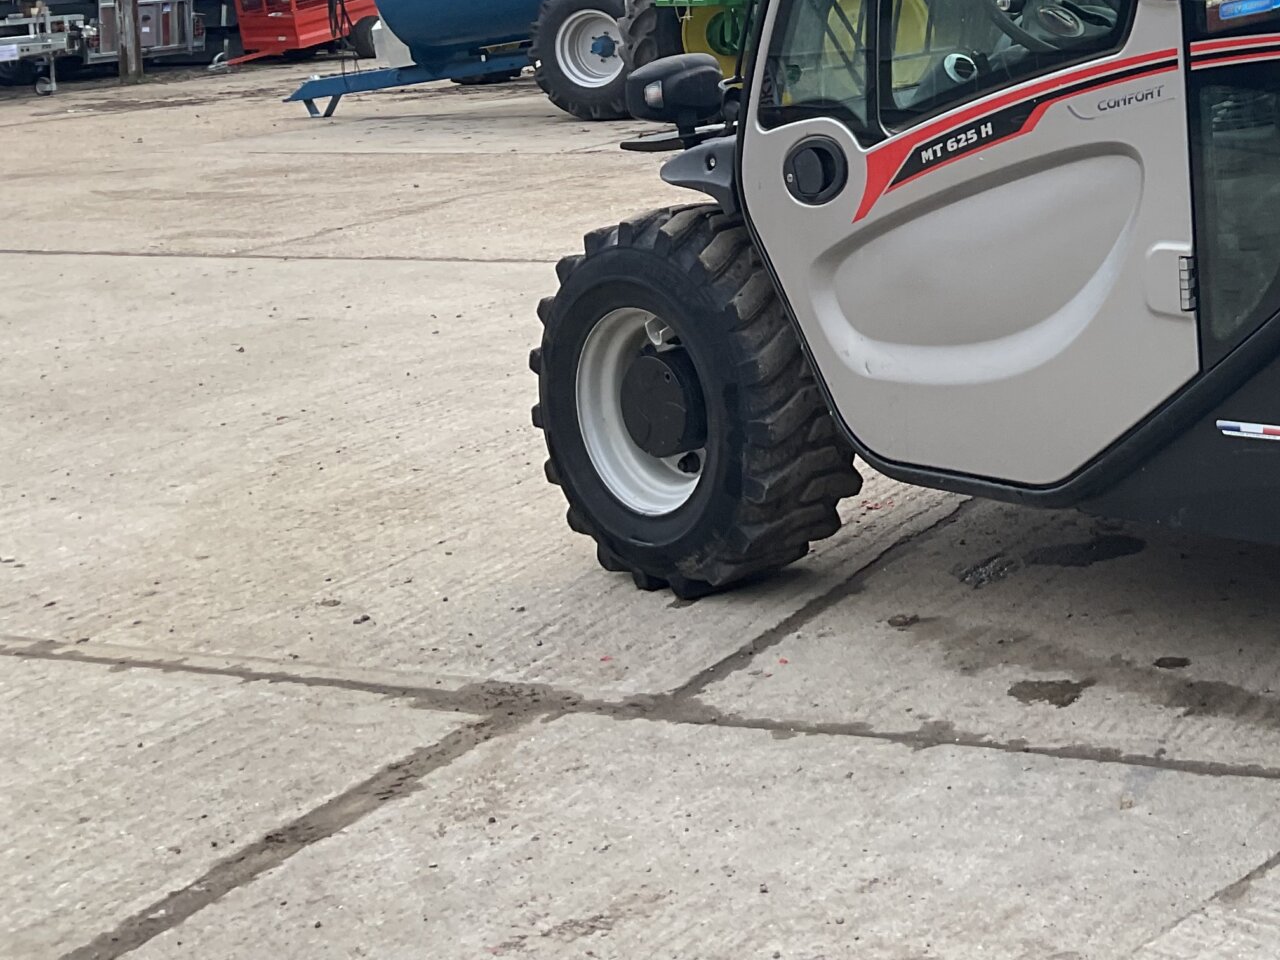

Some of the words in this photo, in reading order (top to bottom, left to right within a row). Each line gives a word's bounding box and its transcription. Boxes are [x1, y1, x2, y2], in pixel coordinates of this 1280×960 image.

[1097, 84, 1165, 111] COMFORT
[920, 142, 944, 164] MT
[946, 128, 978, 152] 625
[980, 121, 993, 139] H
